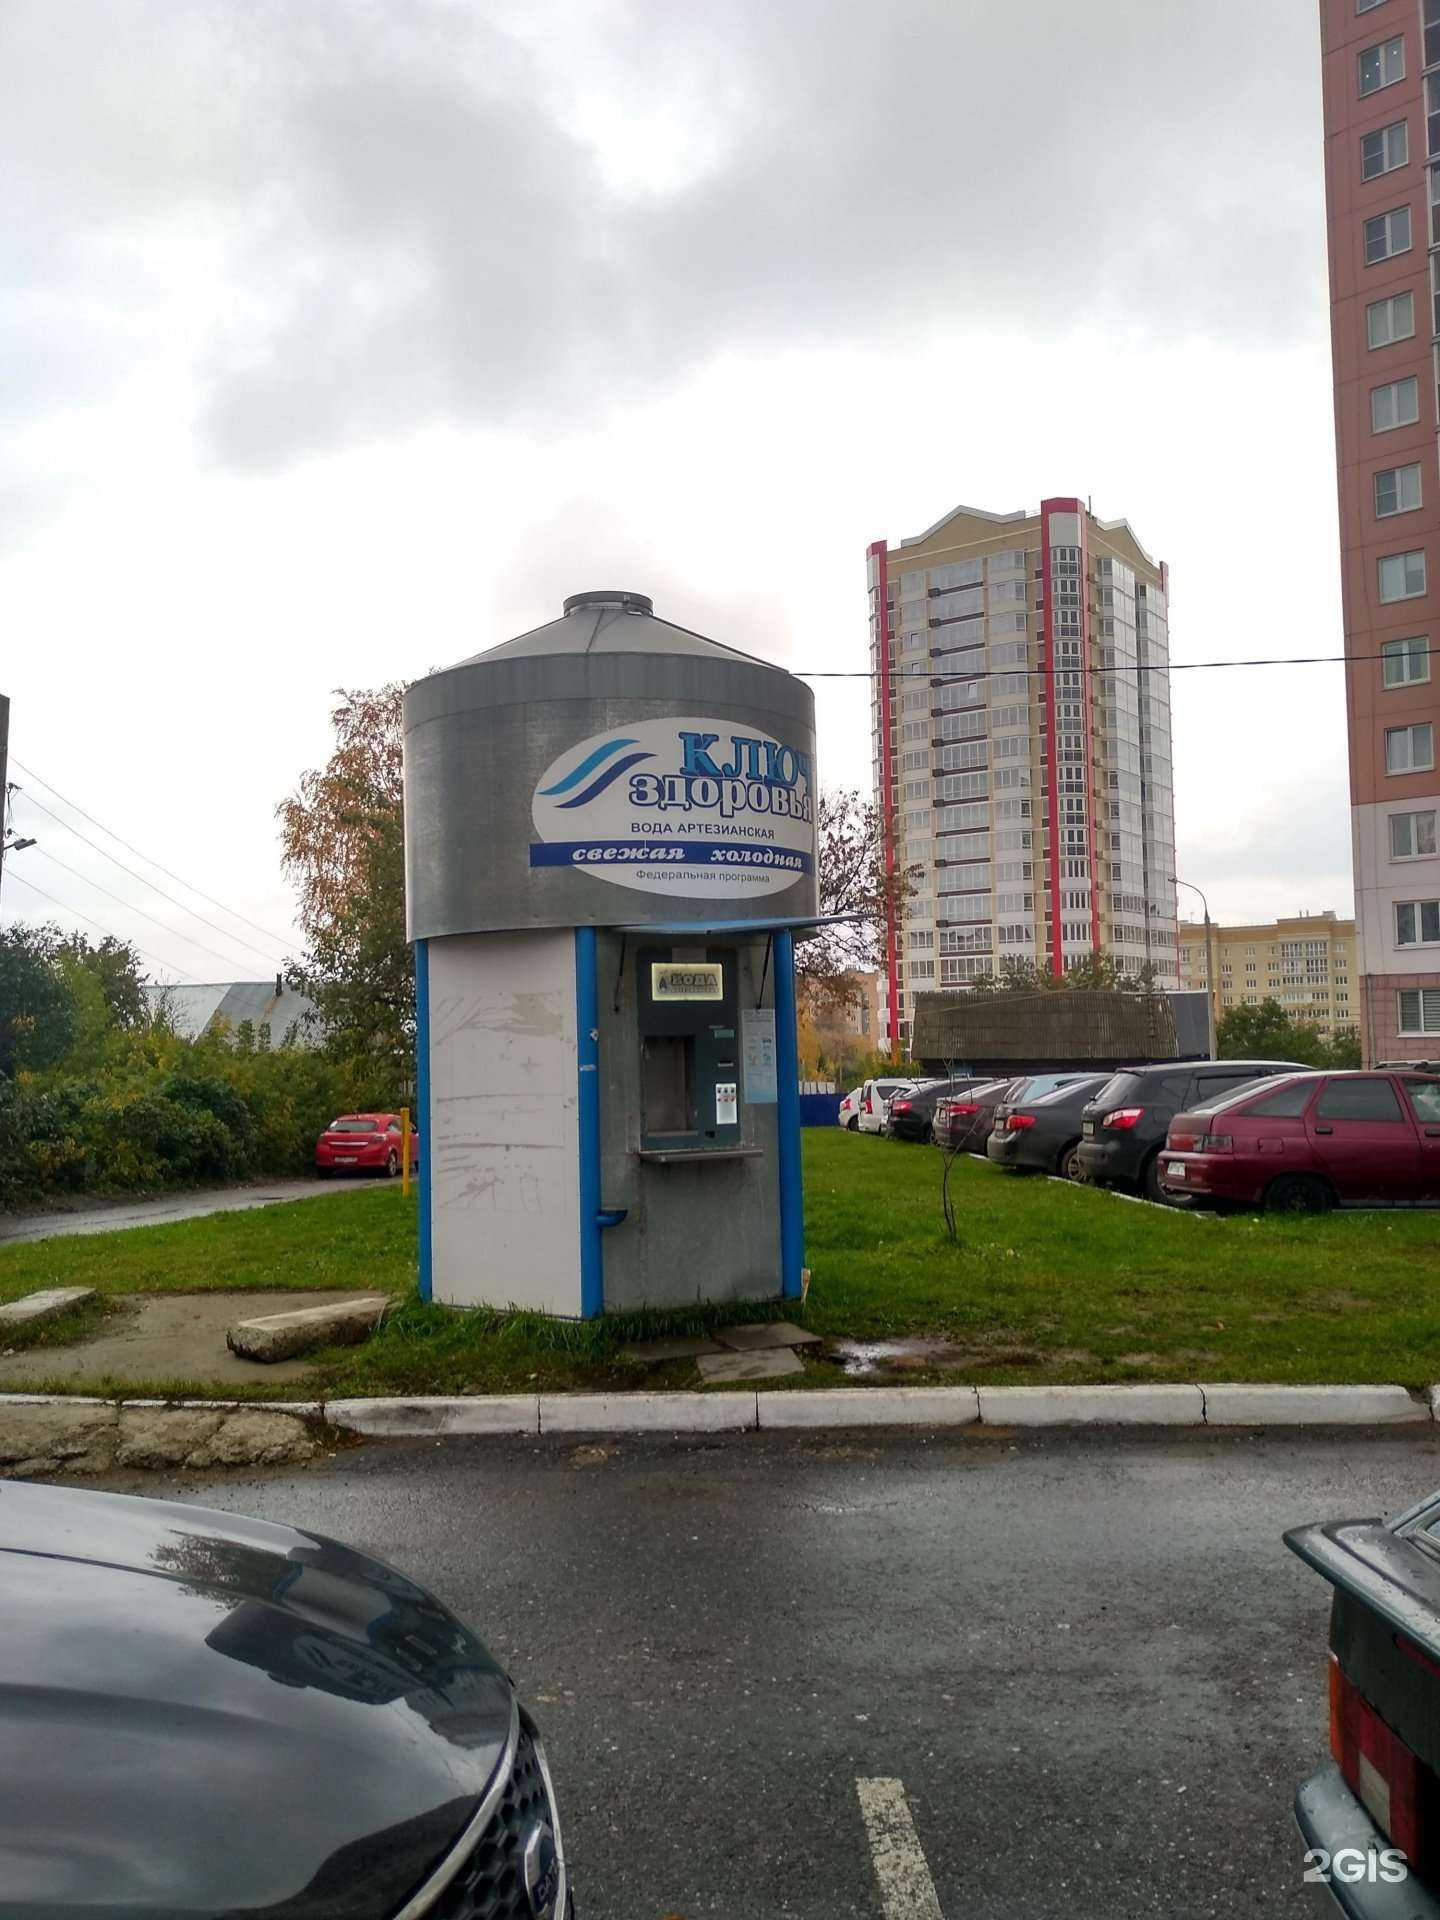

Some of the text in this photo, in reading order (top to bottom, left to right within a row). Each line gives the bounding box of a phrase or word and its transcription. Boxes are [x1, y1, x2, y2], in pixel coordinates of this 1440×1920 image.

[631, 823, 775, 839] ВОДА АРТЕЗИАНСКАЯ
[572, 847, 803, 868] свежая холодная
[636, 870, 770, 884] Федеральная программа
